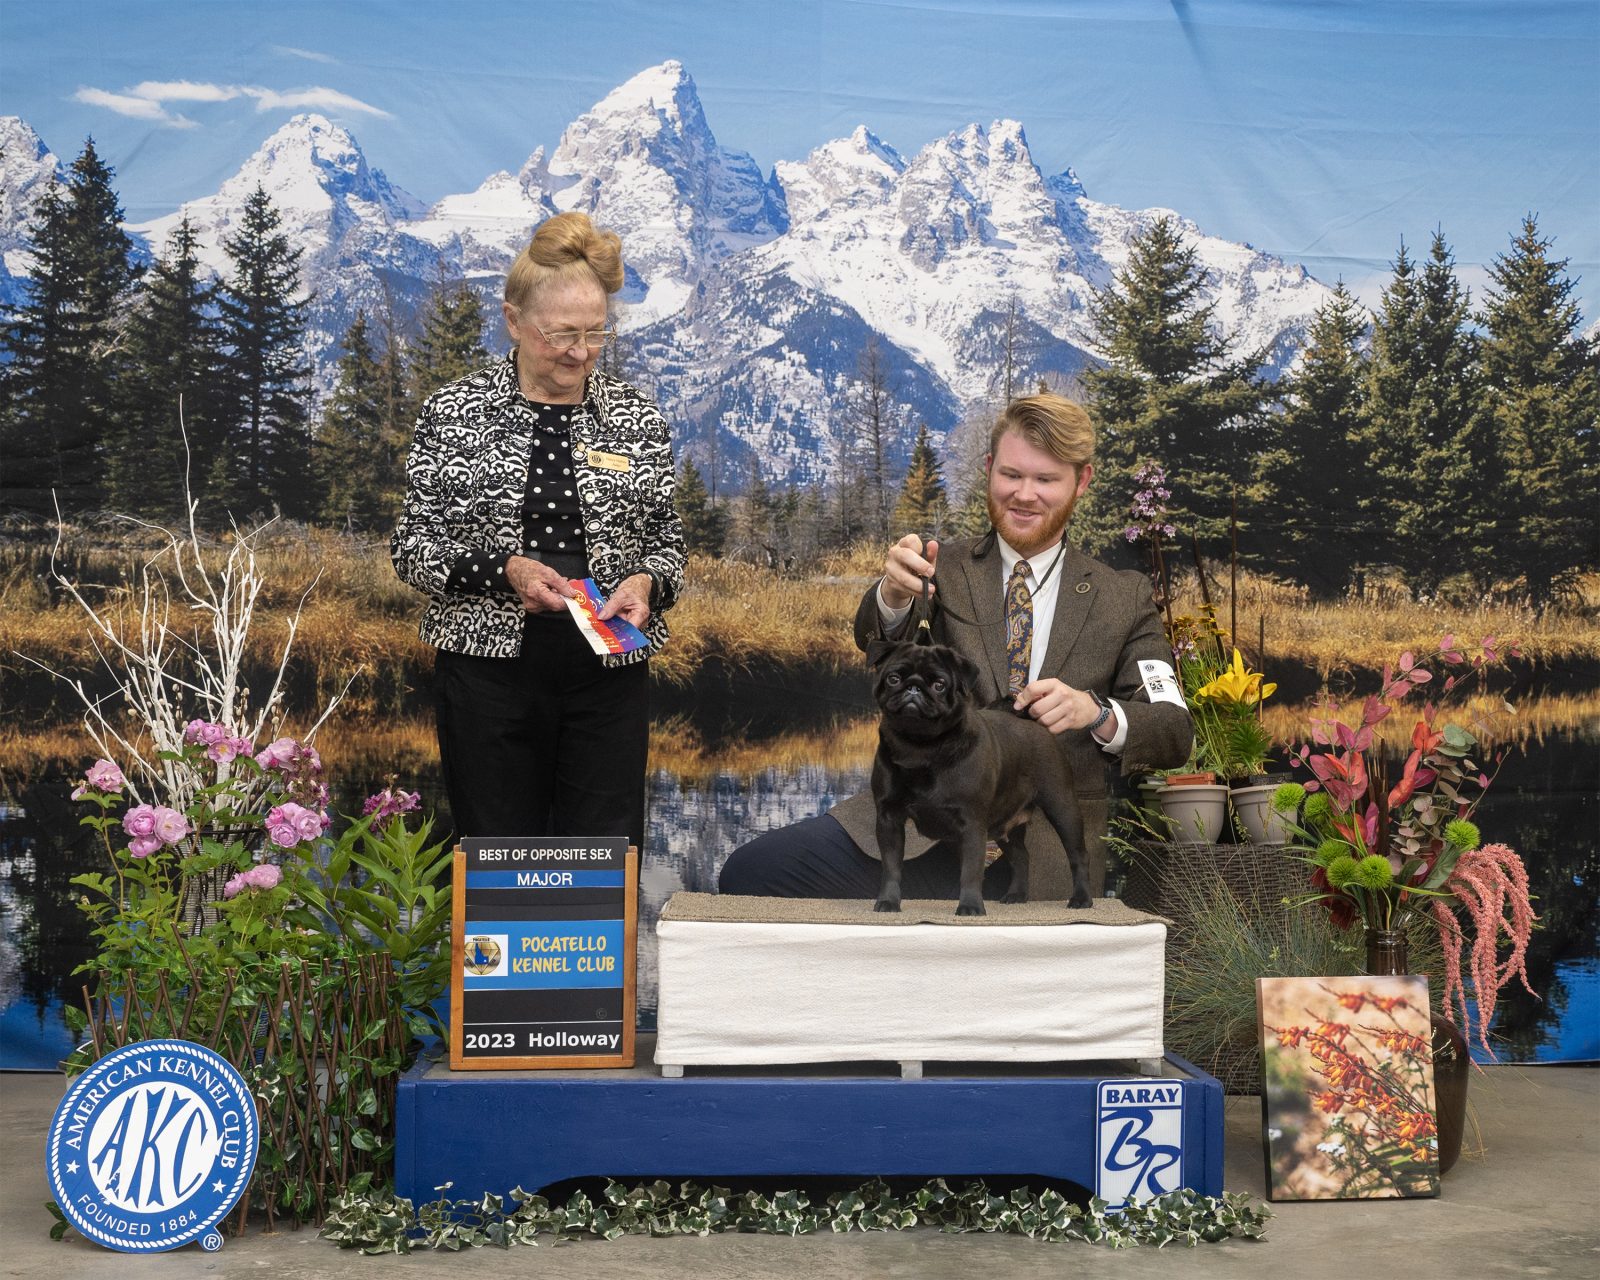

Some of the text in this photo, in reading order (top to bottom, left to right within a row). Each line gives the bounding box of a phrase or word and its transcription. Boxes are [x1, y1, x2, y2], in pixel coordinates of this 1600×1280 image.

[479, 848, 612, 861] BEST OF OPPOSITE SEX
[517, 872, 573, 886] MAJOR
[521, 935, 607, 953] POCATELLO
[512, 956, 615, 974] KENNEL CLUB
[465, 1031, 620, 1049] 2023 Holloway
[1106, 1088, 1179, 1104] BARAY
[65, 1056, 239, 1169] AMERICAN KENNEL CLUB
[91, 1085, 213, 1210] AKC
[77, 1194, 197, 1236] FOUNDED 1884
